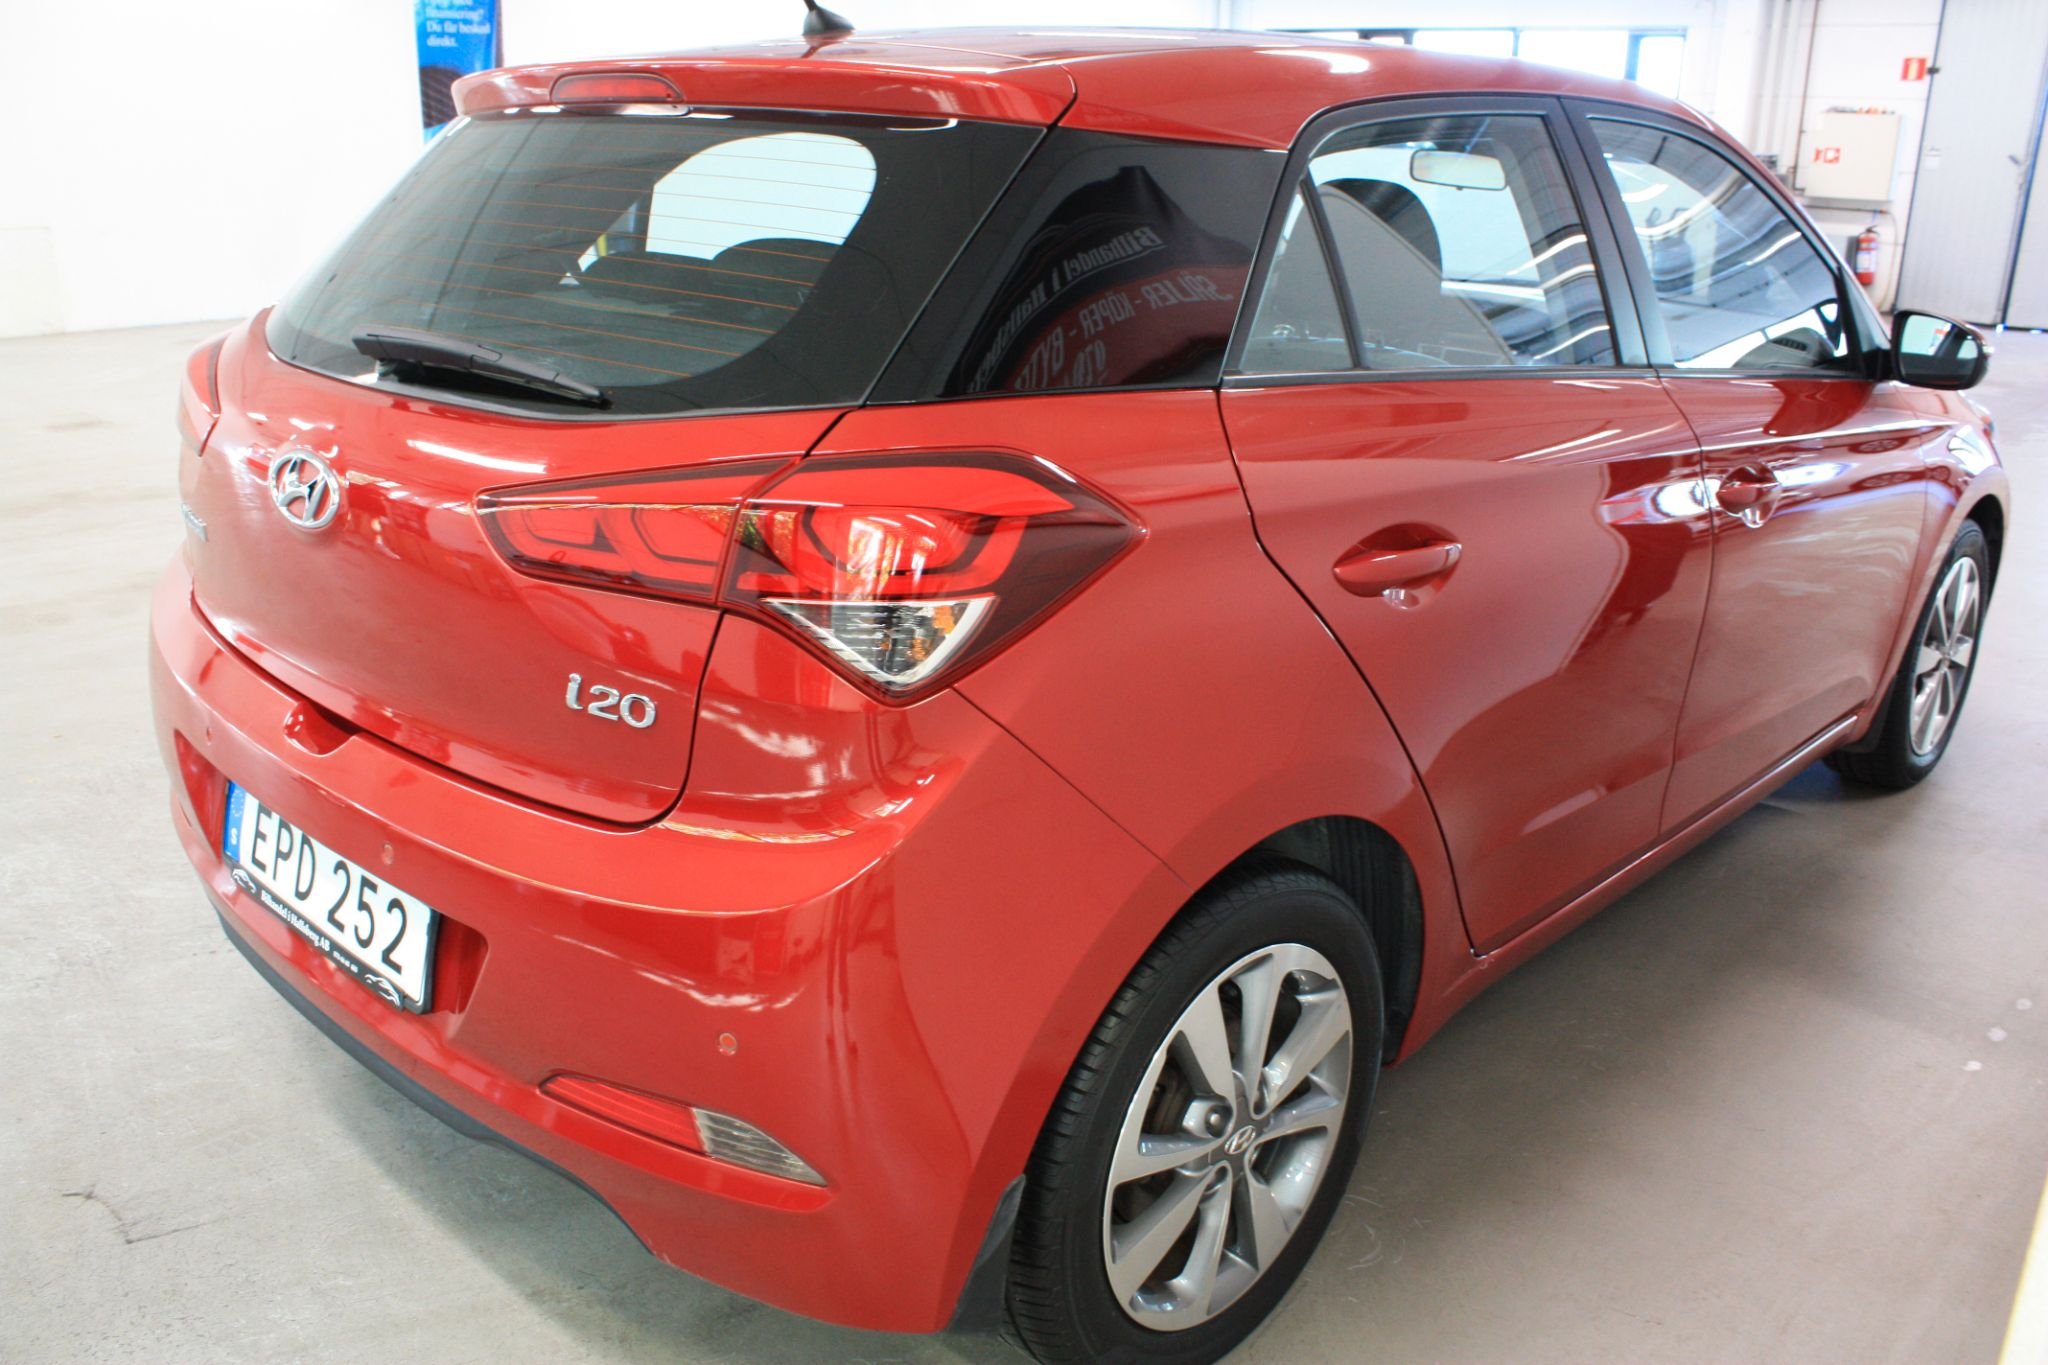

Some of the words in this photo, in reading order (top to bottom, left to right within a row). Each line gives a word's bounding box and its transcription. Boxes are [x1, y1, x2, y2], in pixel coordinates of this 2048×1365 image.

[565, 673, 656, 728] i20
[230, 827, 238, 846] S
[251, 802, 316, 901] EPD
[327, 860, 408, 976] 252
